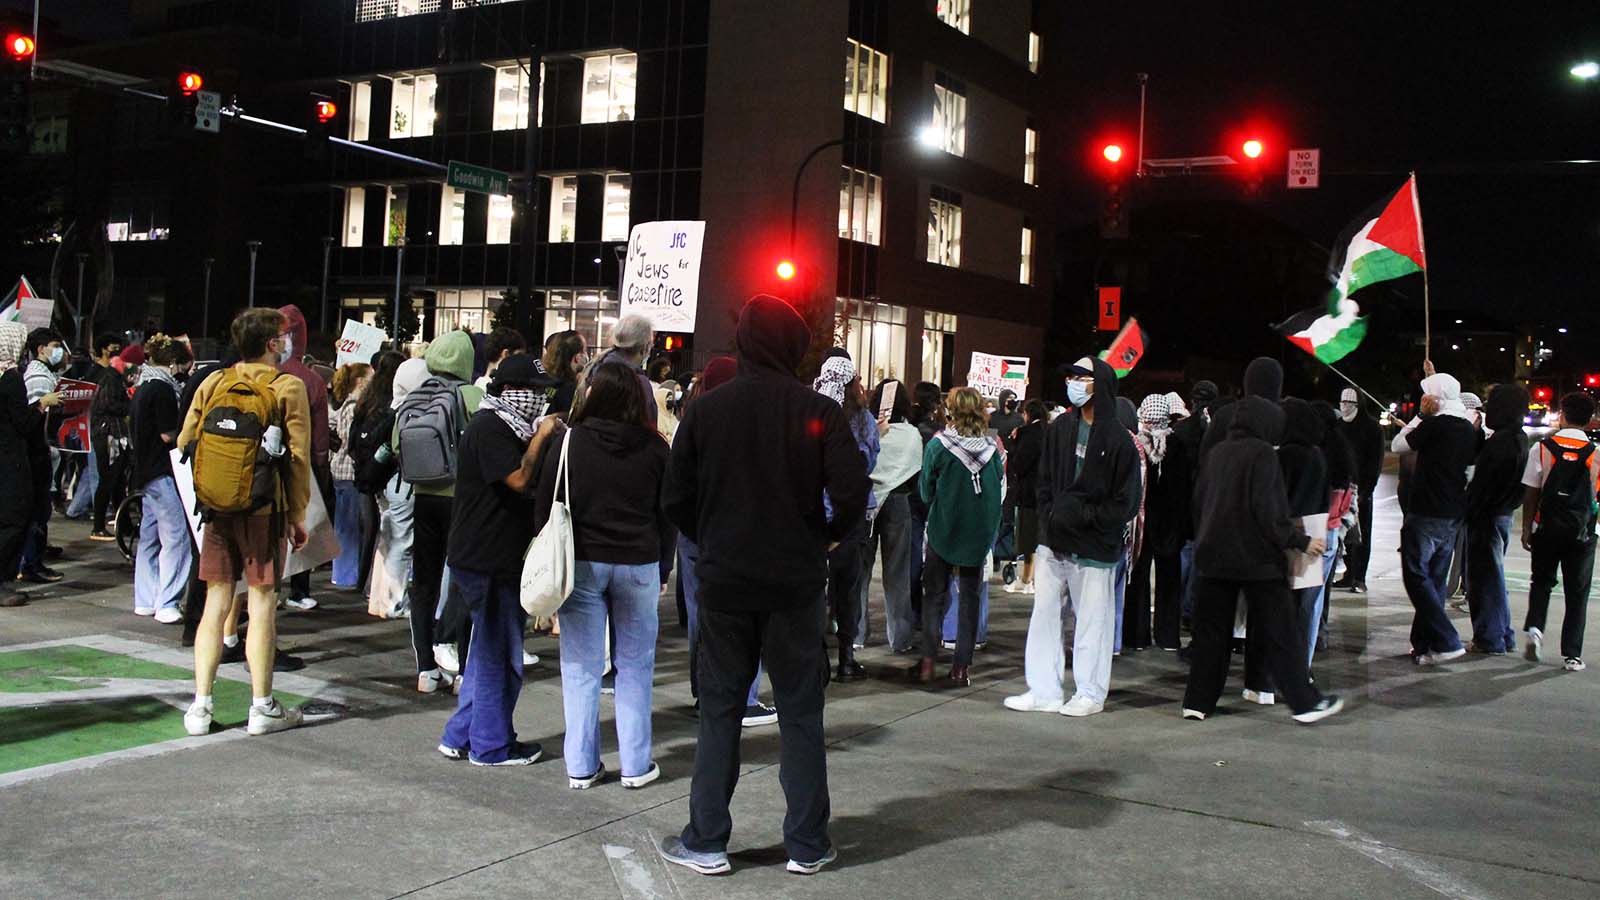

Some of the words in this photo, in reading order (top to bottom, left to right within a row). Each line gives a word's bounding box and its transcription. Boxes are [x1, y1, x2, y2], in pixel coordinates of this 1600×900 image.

[201, 93, 214, 103] NO
[1297, 152, 1310, 160] NO
[454, 167, 485, 187] Goodwin
[637, 252, 670, 279] Jews
[1105, 301, 1115, 317] I
[975, 355, 998, 368] EYES
[980, 366, 991, 374] ON
[972, 372, 1020, 390] PALESTINE
[62, 389, 94, 399] CTOBER
